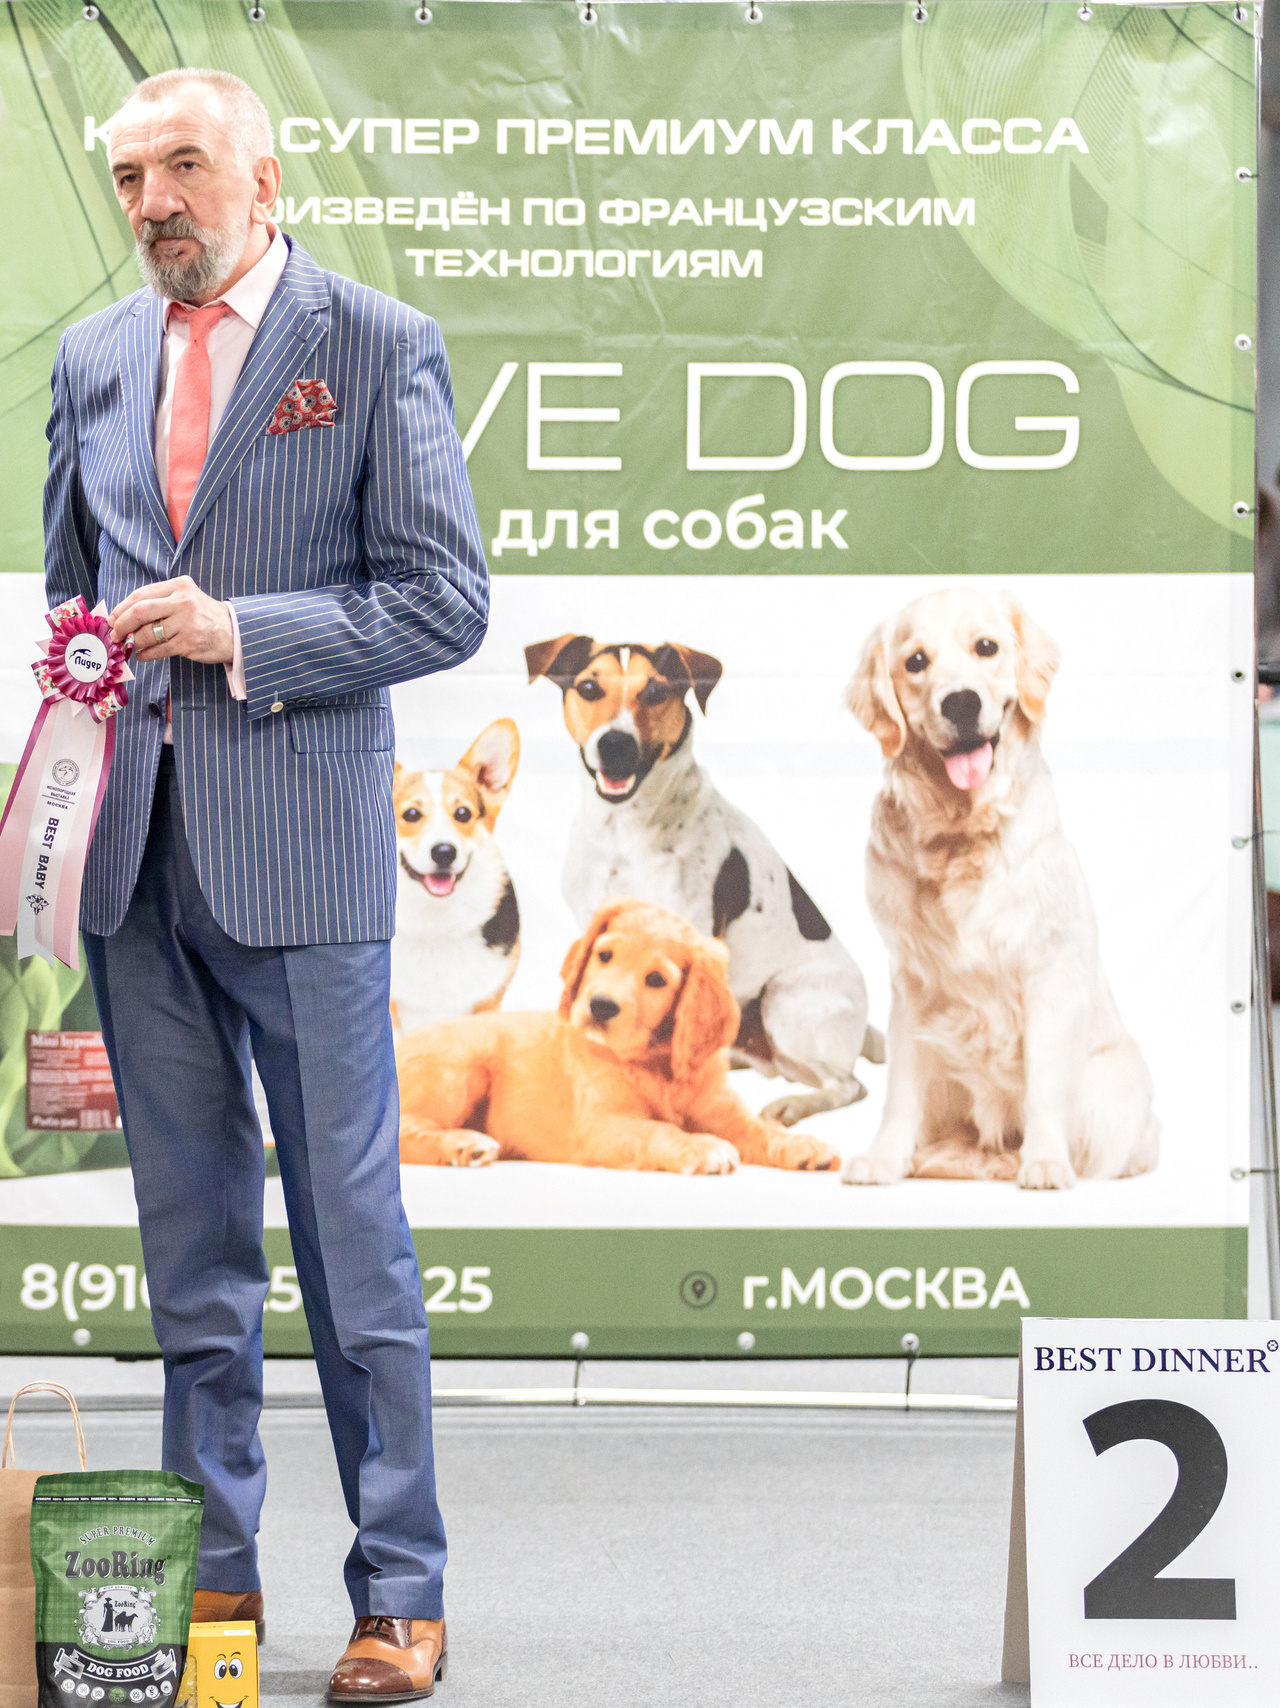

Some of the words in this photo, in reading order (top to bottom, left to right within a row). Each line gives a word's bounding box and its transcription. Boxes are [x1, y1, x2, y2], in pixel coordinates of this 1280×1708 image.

[280, 117, 480, 154] СУПЕР
[497, 118, 814, 155] ПРЕМИУМ
[832, 118, 1090, 155] КЛАССА
[524, 197, 587, 226] ПО
[598, 196, 976, 232] ФРАНЦУЗСКИМ
[405, 248, 763, 278] ТЕХНОЛОГИЯМ
[686, 360, 1080, 471] DOG
[491, 509, 620, 557] для
[642, 493, 849, 549] собак
[74, 655, 102, 672] Лидер
[41, 816, 60, 850] BEST
[34, 854, 50, 890] BABY
[743, 1266, 1032, 1310] г.МОСКВА
[1034, 1346, 1122, 1372] BEST
[1132, 1348, 1271, 1373] DINNER
[1082, 1398, 1237, 1621] 2
[79, 1526, 110, 1546] SUPER
[112, 1525, 156, 1547] PREMIUM
[64, 1550, 166, 1587] ZooRing
[114, 1600, 137, 1609] ZooRing
[86, 1662, 114, 1678] DOG
[116, 1663, 150, 1678] FOOD
[1068, 1653, 1104, 1669] ВСЕ
[1107, 1654, 1158, 1672] ДЕЛО
[1163, 1654, 1175, 1670] В
[1178, 1654, 1259, 1670] ЛЮБВИ..
